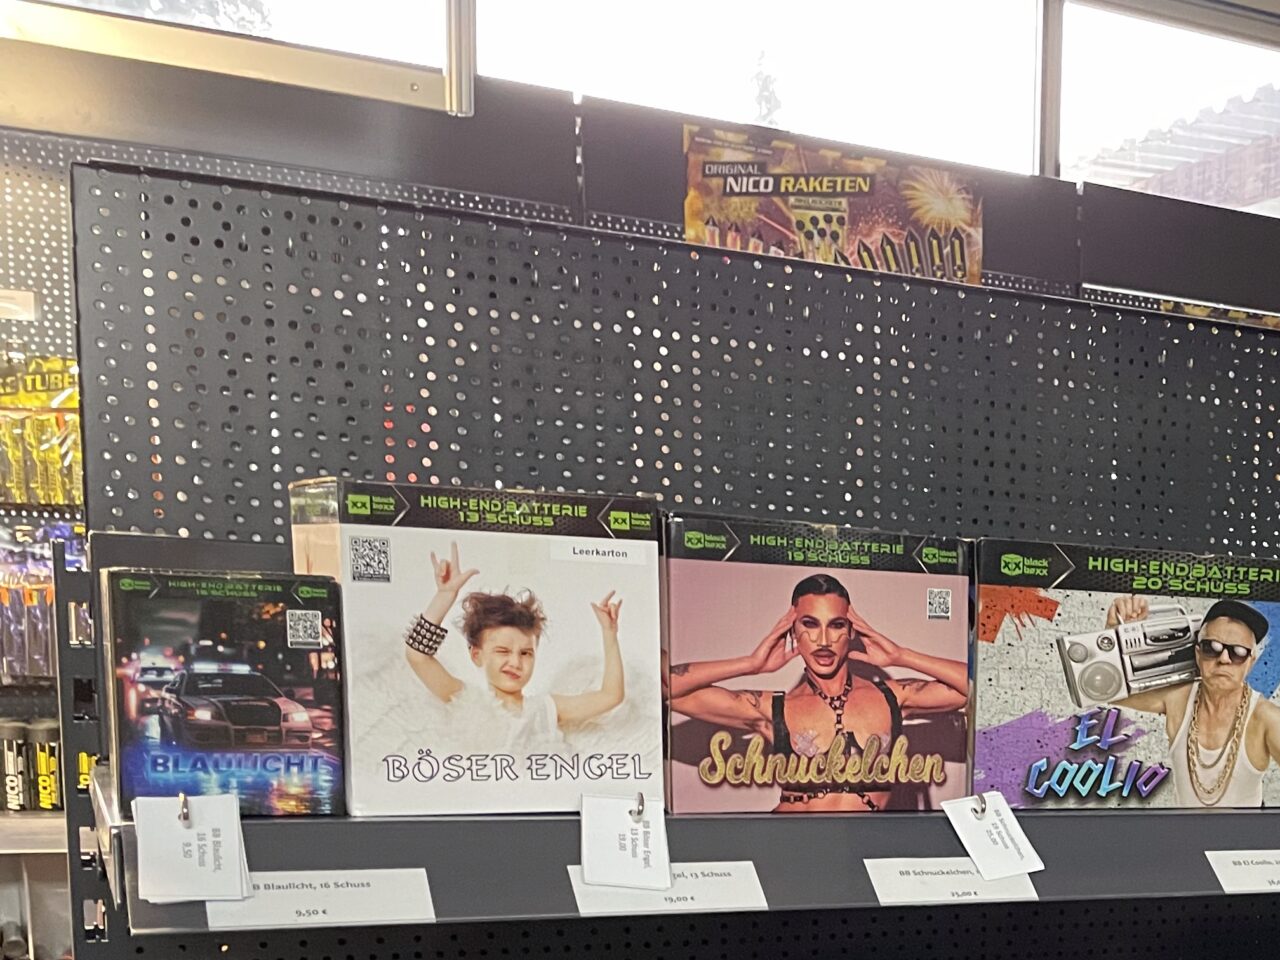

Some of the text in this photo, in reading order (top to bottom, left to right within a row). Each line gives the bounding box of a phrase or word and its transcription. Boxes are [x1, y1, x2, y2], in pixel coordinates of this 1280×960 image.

[705, 164, 761, 175] ORIGINAL
[726, 176, 870, 193] NICO RAKETEN
[421, 495, 588, 518] HIGH-END BATTERIE
[459, 511, 555, 527] 13 SCHUSS
[572, 546, 629, 559] Leerkarton
[750, 534, 904, 555] HIGH-END BATTERIE
[787, 551, 871, 566] 19 SCHUSS
[1088, 556, 1190, 577] HIGH-END
[1132, 575, 1251, 594] 20 SCHUSS
[1070, 707, 1129, 752] EL
[151, 752, 325, 775] BLAULICHT
[382, 748, 652, 782] BÖSER ENGEL
[699, 731, 946, 789] Schnuckelchen
[1025, 755, 1171, 799] COOLIO
[6, 775, 20, 811] NICO
[39, 775, 53, 811] NICO
[701, 870, 732, 879] Schuss
[264, 882, 317, 891] Blaulicht,
[333, 880, 371, 890] Schuss
[295, 909, 319, 918] 9,50
